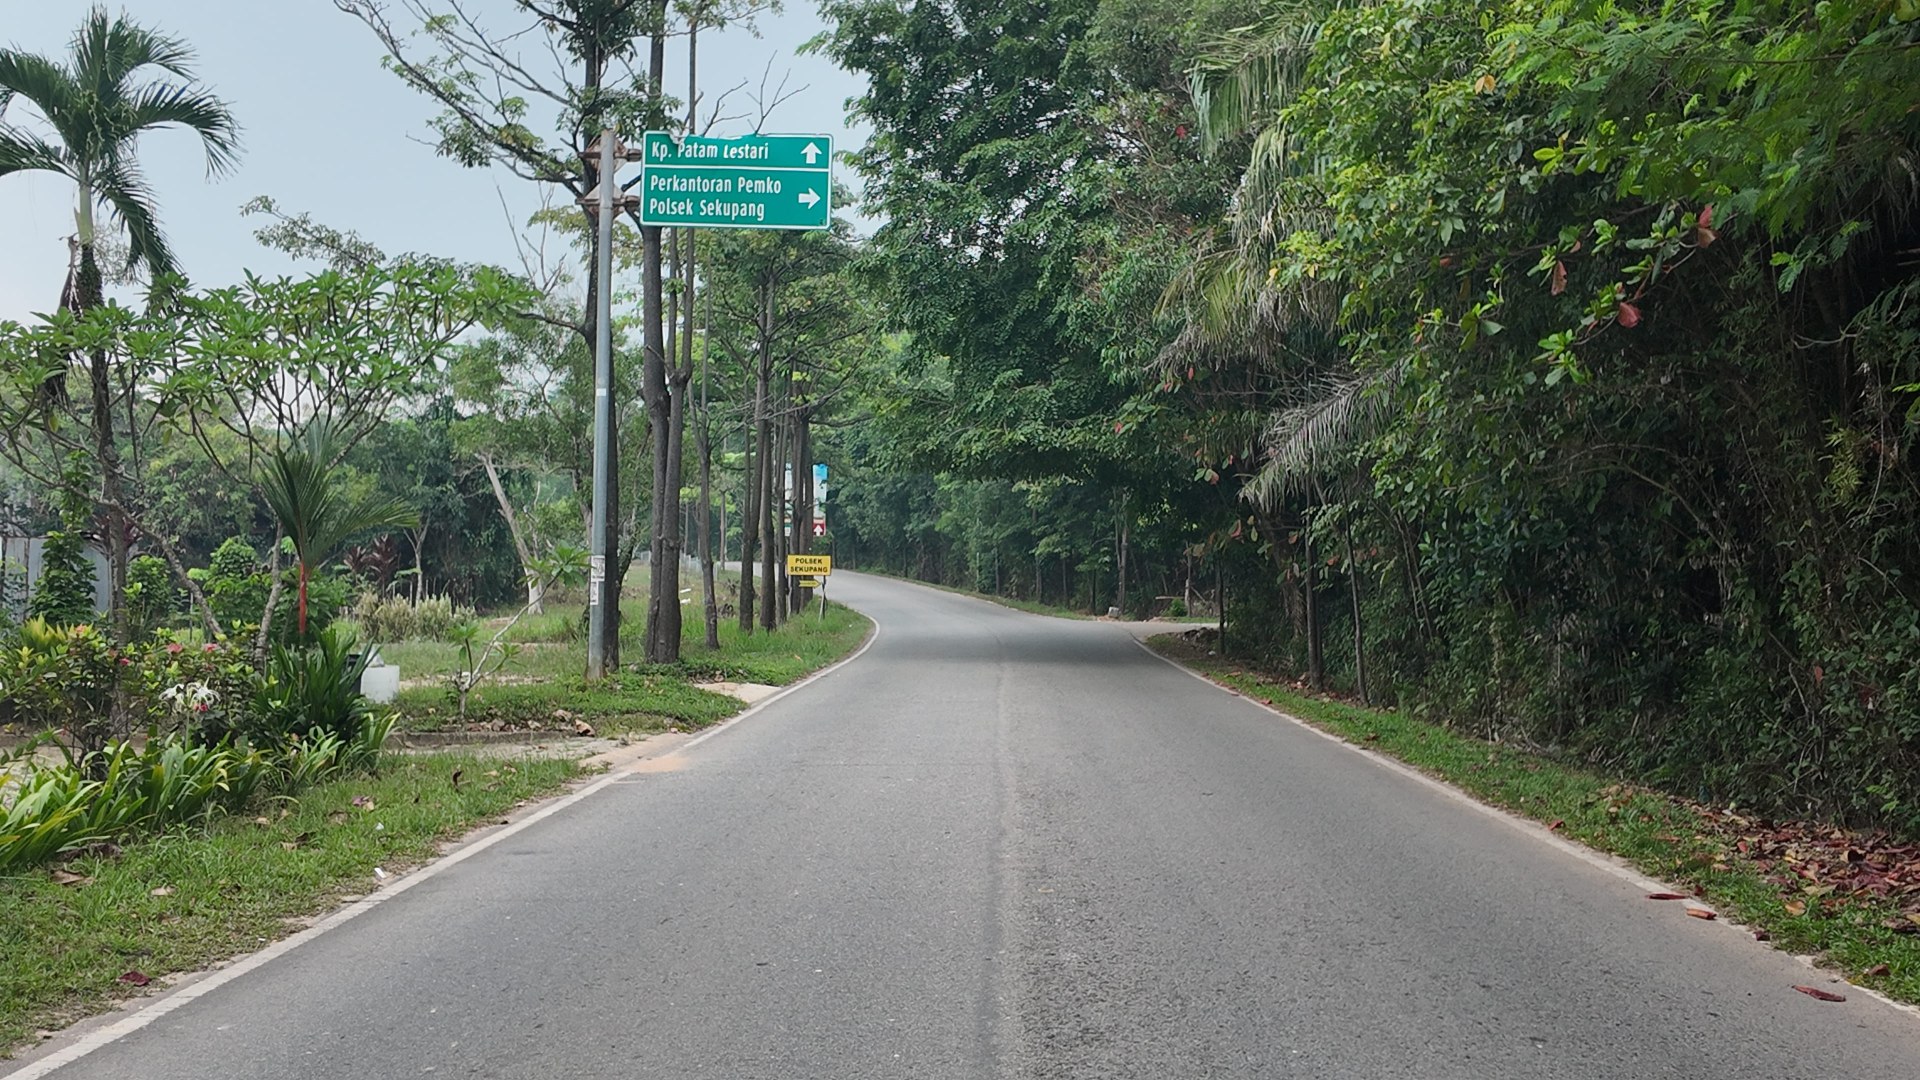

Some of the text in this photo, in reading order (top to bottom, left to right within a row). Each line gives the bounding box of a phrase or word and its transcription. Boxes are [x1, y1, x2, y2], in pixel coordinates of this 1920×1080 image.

[651, 141, 769, 162] Kp. Patam Lestari
[650, 174, 782, 194] Perkantoran Pemko
[649, 198, 765, 221] Polsek Sekupang
[795, 557, 823, 565] POLSEK
